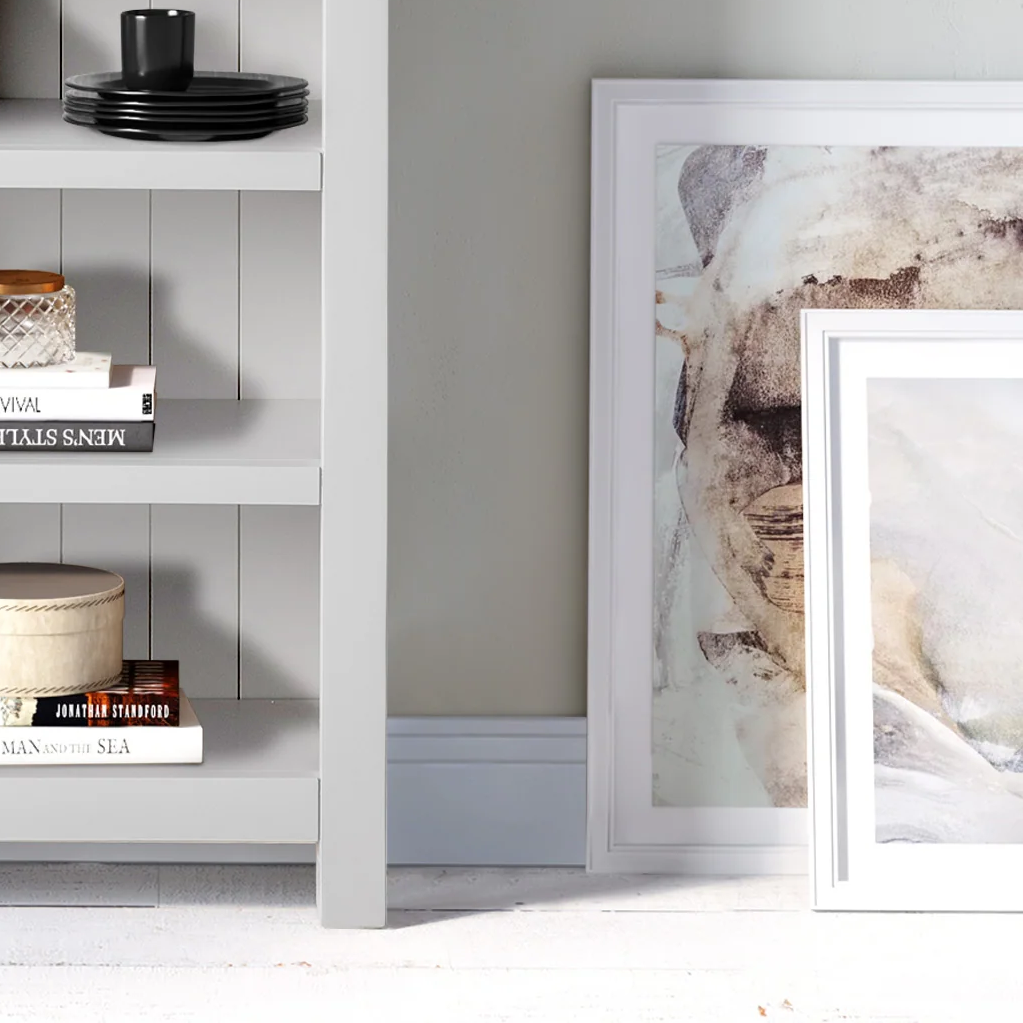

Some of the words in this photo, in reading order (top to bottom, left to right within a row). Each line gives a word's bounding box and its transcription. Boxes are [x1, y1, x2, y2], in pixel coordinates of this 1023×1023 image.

[63, 428, 126, 446] MEN'S
[55, 703, 107, 719] JONATHAN
[112, 704, 170, 719] STANDFORD
[2, 739, 41, 755] MAN
[43, 744, 67, 754] AND
[67, 744, 91, 754] THE
[97, 738, 131, 754] SEA
